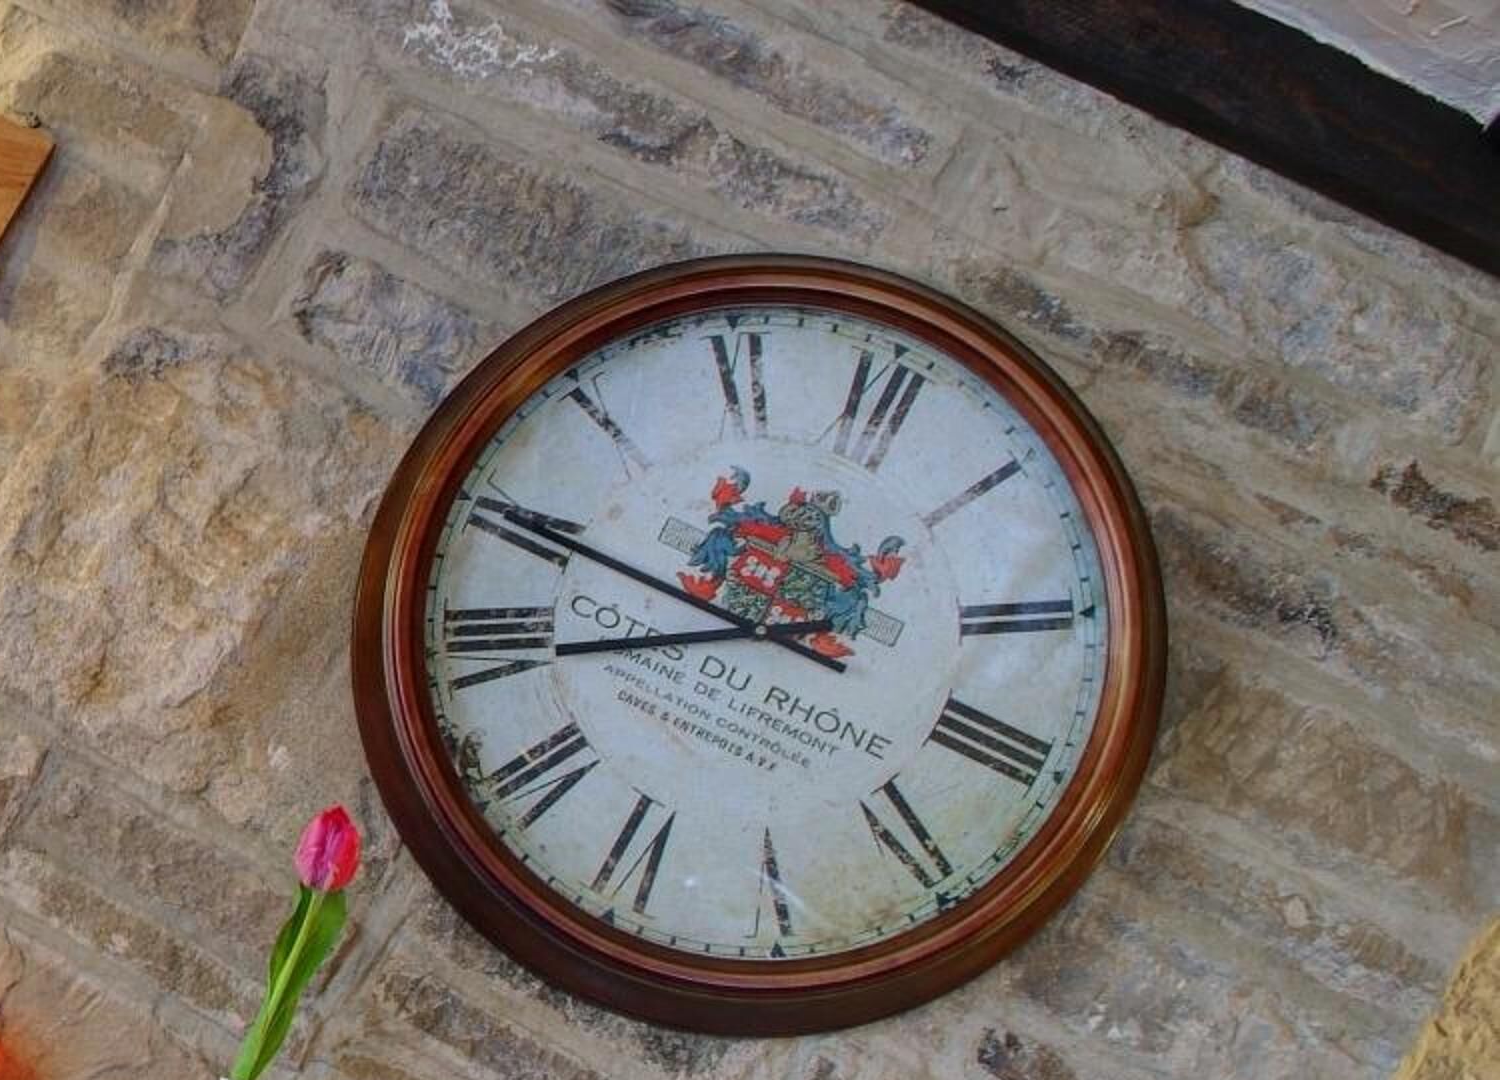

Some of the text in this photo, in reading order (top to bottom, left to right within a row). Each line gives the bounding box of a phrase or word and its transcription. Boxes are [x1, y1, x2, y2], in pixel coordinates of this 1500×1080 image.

[600, 635, 687, 685] MAINE
[693, 681, 722, 701] DE
[699, 655, 753, 692] DU
[763, 685, 894, 761] RHÔNE
